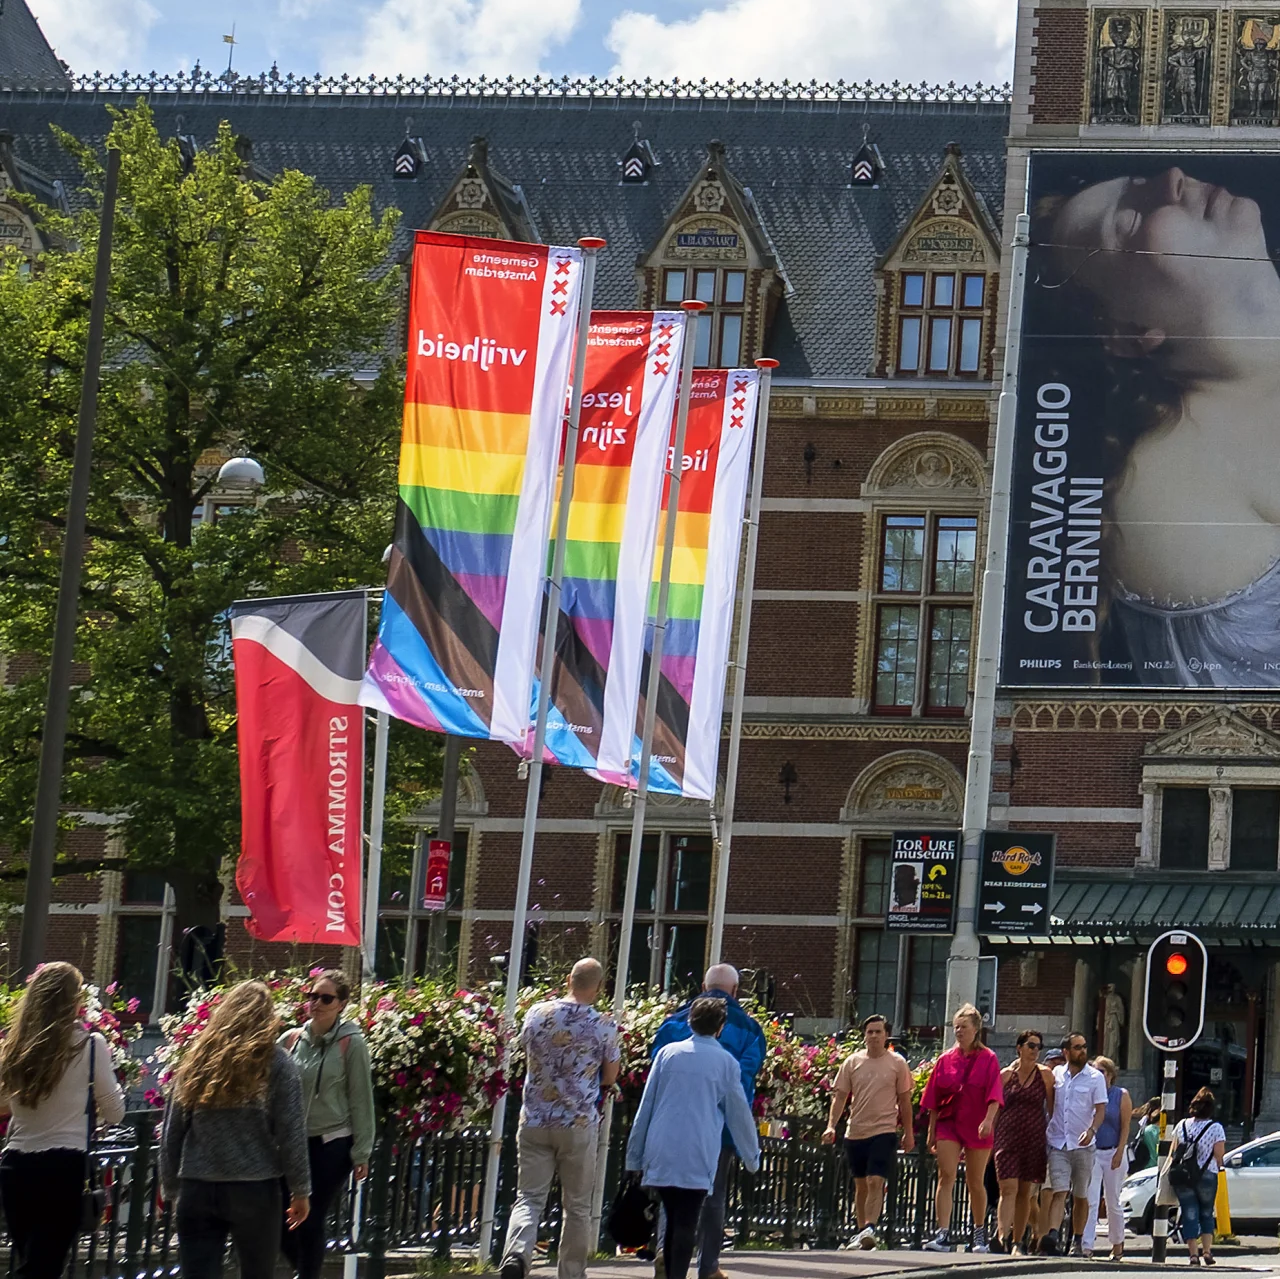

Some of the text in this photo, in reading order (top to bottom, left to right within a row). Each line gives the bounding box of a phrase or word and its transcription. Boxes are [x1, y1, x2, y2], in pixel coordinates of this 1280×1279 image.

[1023, 381, 1073, 635] CARAVAGGIO
[1062, 475, 1106, 633] BERNINI
[1019, 659, 1062, 669] PHILIPS
[1144, 661, 1163, 670] ING
[1203, 660, 1221, 673] kpn
[896, 835, 956, 852] TORTURE
[894, 850, 955, 860] museum
[991, 850, 1042, 866] Hard Rock
